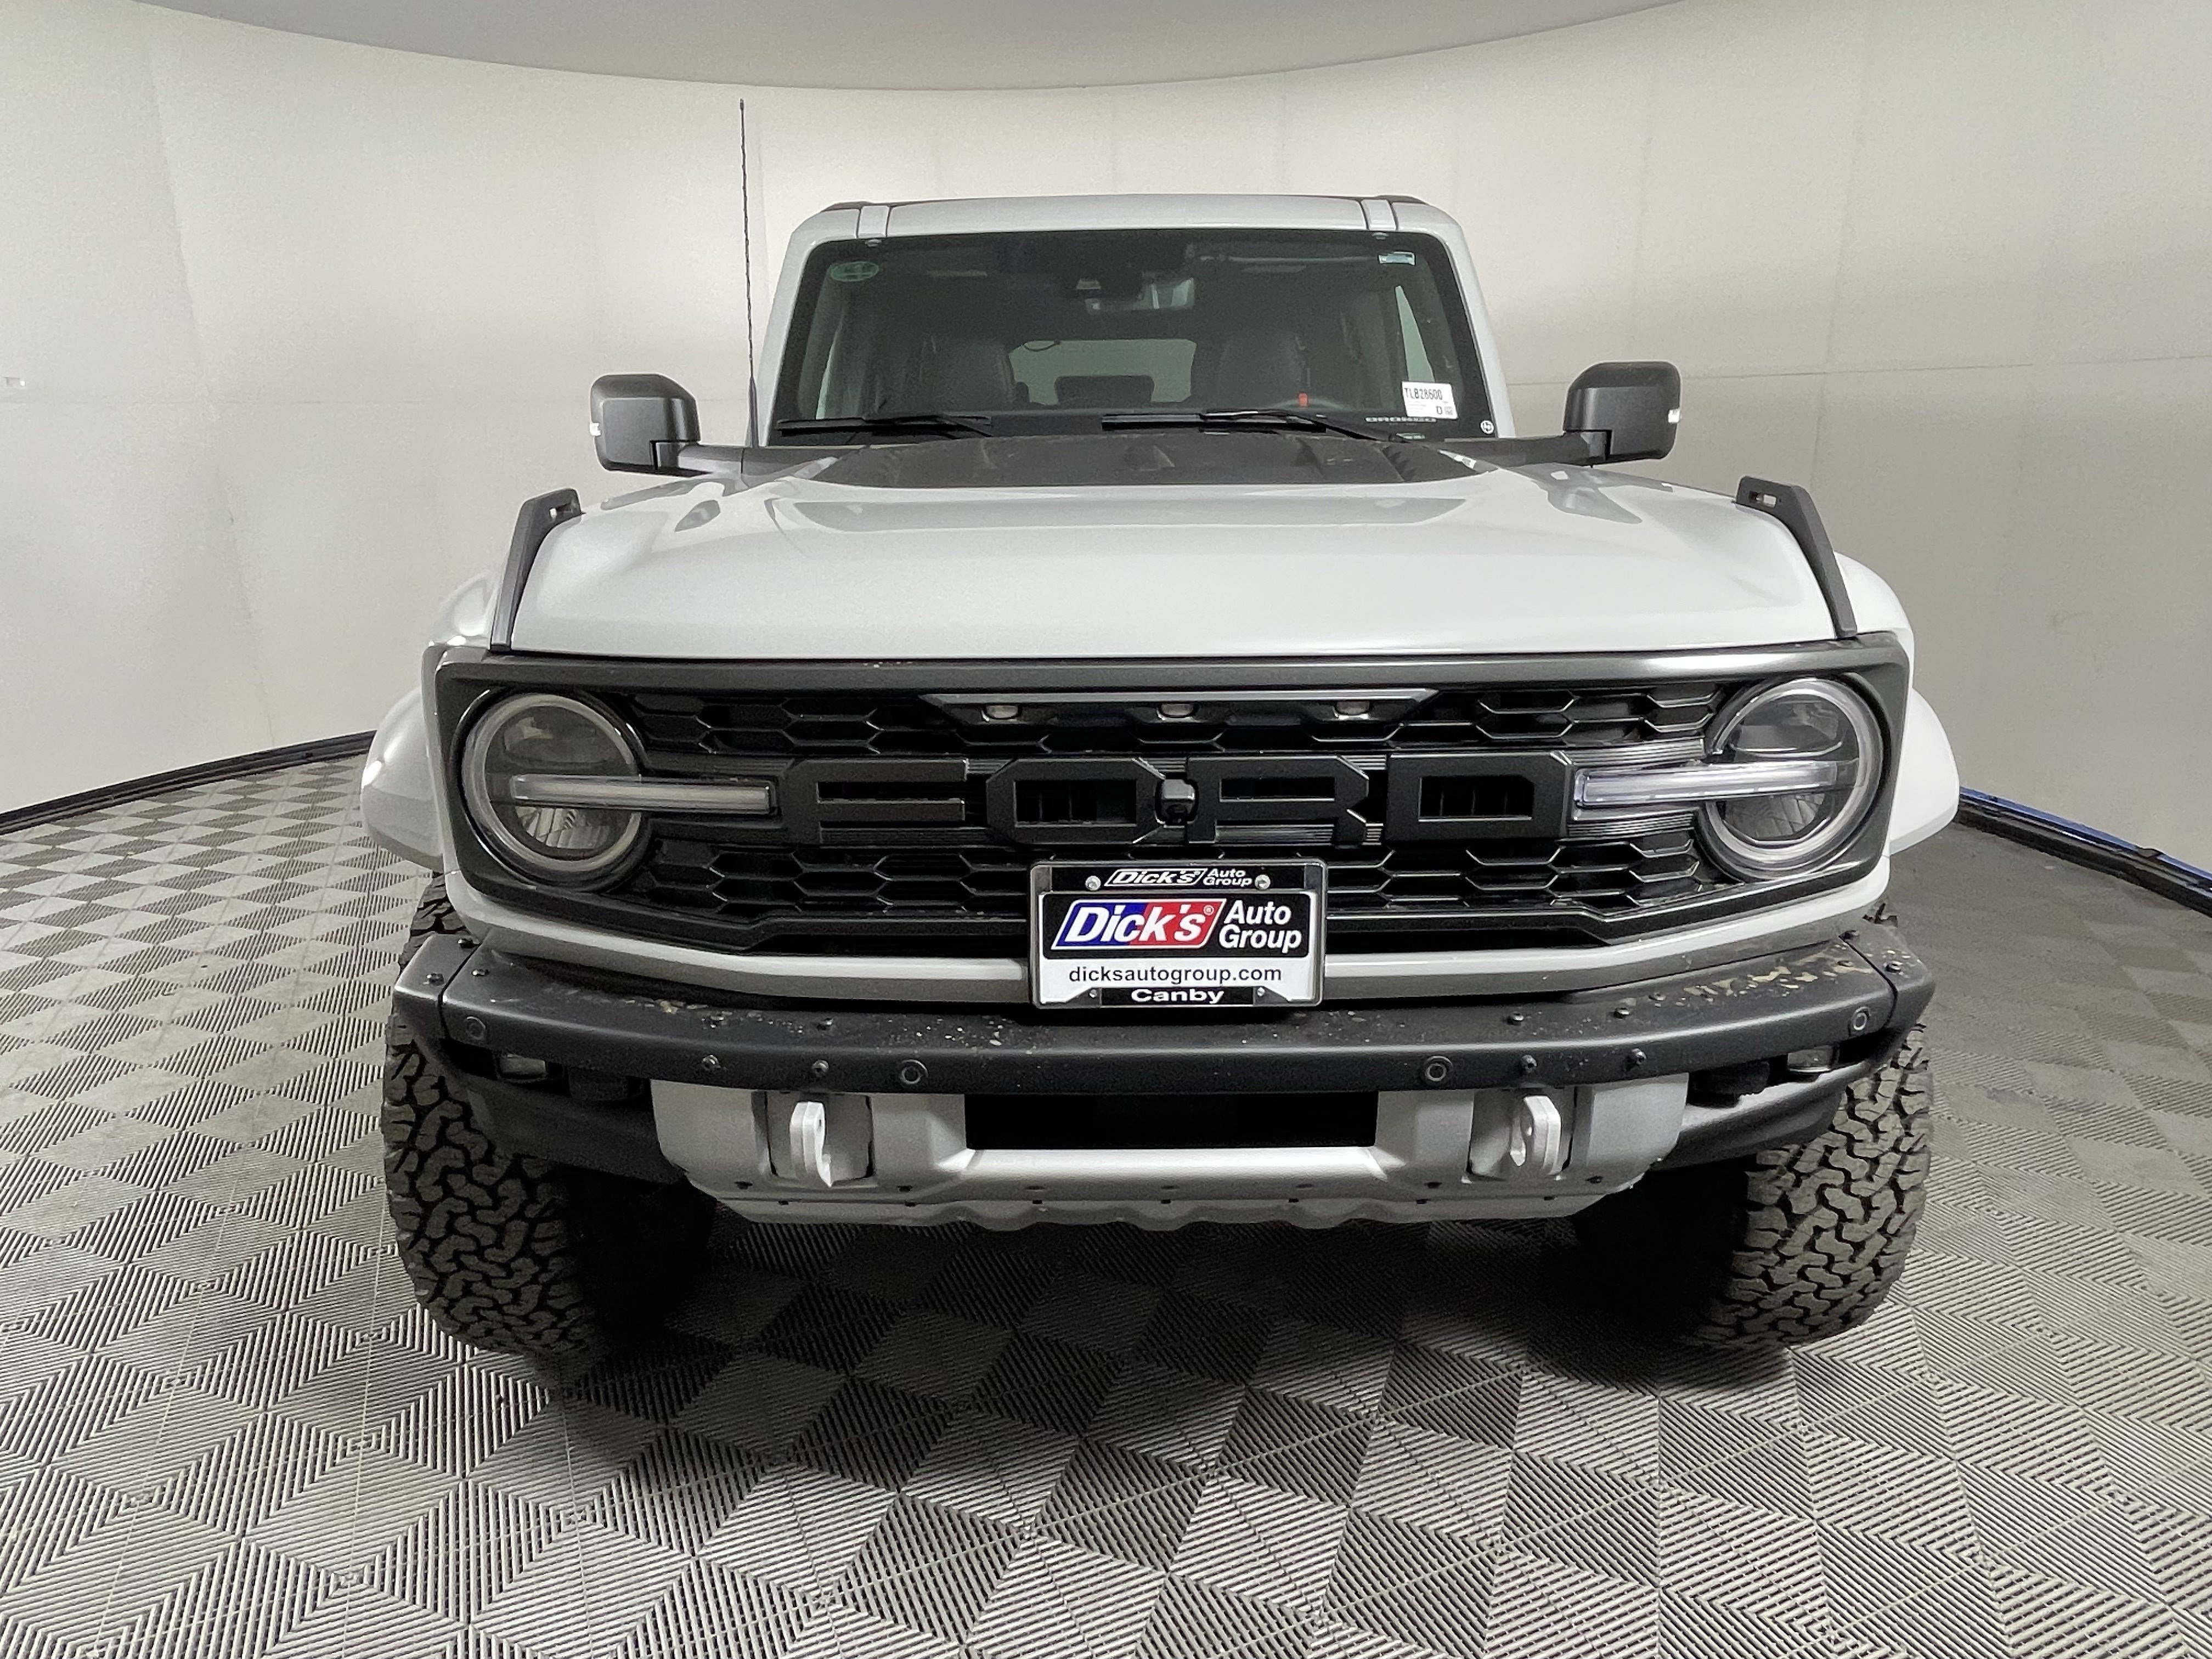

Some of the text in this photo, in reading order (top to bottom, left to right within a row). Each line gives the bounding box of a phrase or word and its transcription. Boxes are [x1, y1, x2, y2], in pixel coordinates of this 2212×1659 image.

[782, 754, 1567, 847] FORD
[1207, 868, 1246, 877] Auto
[1203, 877, 1252, 887] Group
[1224, 900, 1291, 924] Auto
[1219, 924, 1302, 953] Group
[1069, 967, 1282, 984] dicksautogroup.com
[1131, 989, 1224, 1003] Canby
